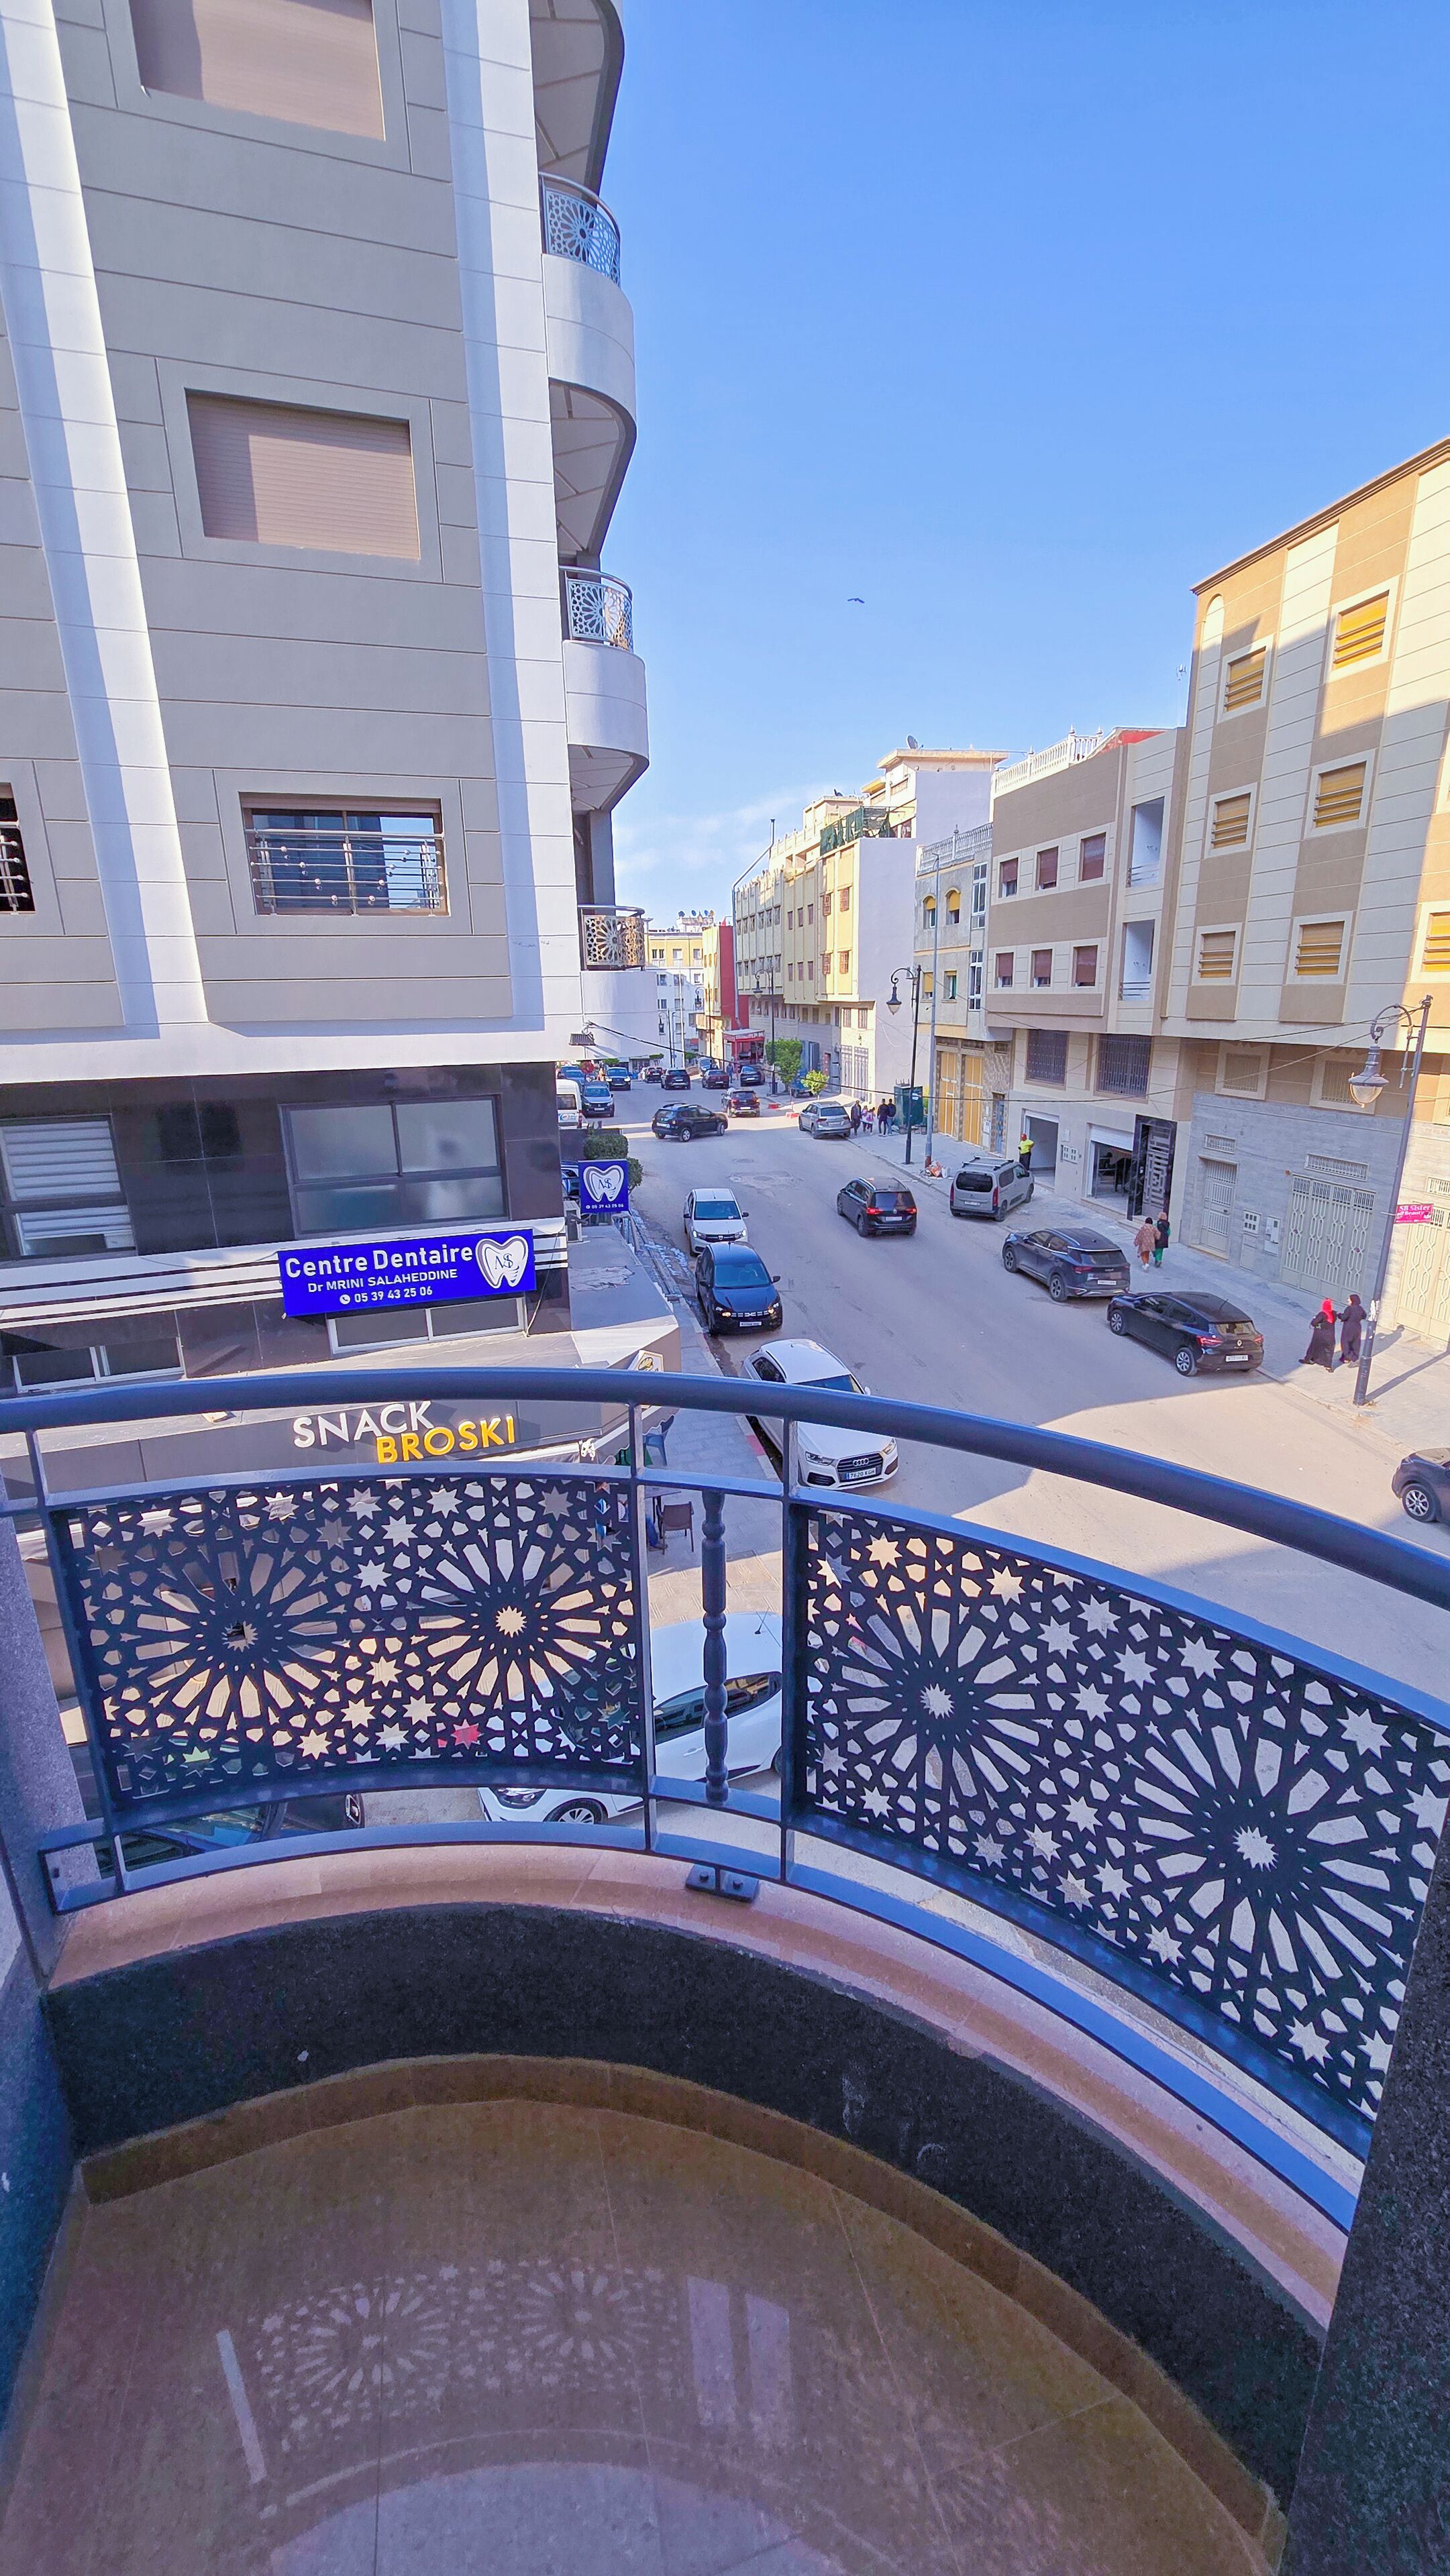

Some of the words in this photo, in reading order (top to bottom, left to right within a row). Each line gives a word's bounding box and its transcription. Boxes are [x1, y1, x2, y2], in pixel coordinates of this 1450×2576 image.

[285, 1256, 368, 1278] Centre
[373, 1244, 473, 1270] Dentaire
[308, 1283, 323, 1293] Dr
[327, 1278, 364, 1291] MRINI
[368, 1269, 458, 1287] SALAHEDDINE
[354, 1293, 368, 1303] 05
[371, 1291, 384, 1301] 39
[387, 1289, 401, 1299] 43
[403, 1287, 417, 1298] 25
[419, 1286, 433, 1296] 06
[293, 1401, 434, 1448] SNACK
[376, 1413, 515, 1464] BROSKI
